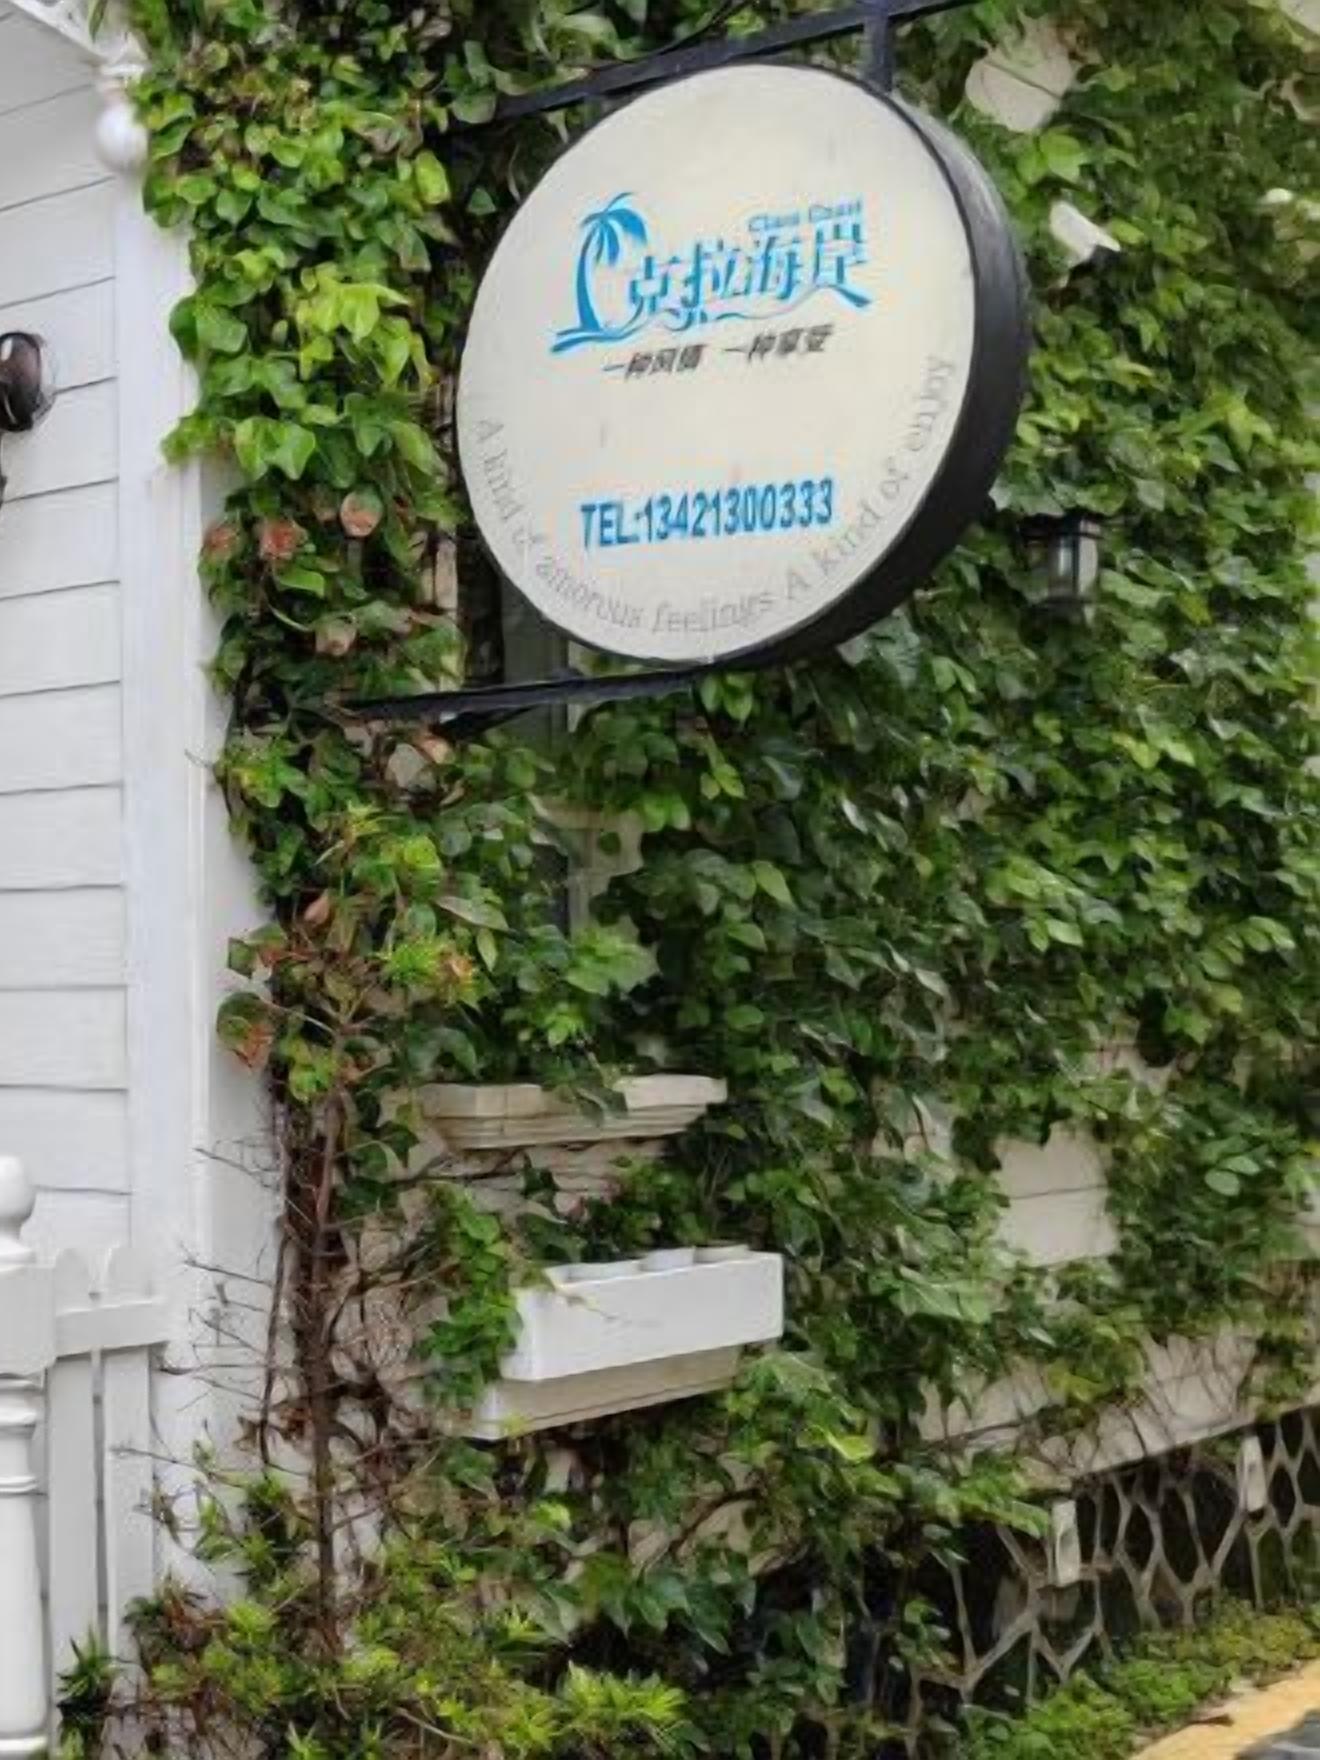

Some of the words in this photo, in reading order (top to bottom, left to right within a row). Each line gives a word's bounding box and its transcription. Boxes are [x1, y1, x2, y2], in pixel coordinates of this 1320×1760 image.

[628, 220, 866, 322] 克拉海岸
[579, 477, 833, 549] TEL:13421300333
[787, 568, 814, 600] A
